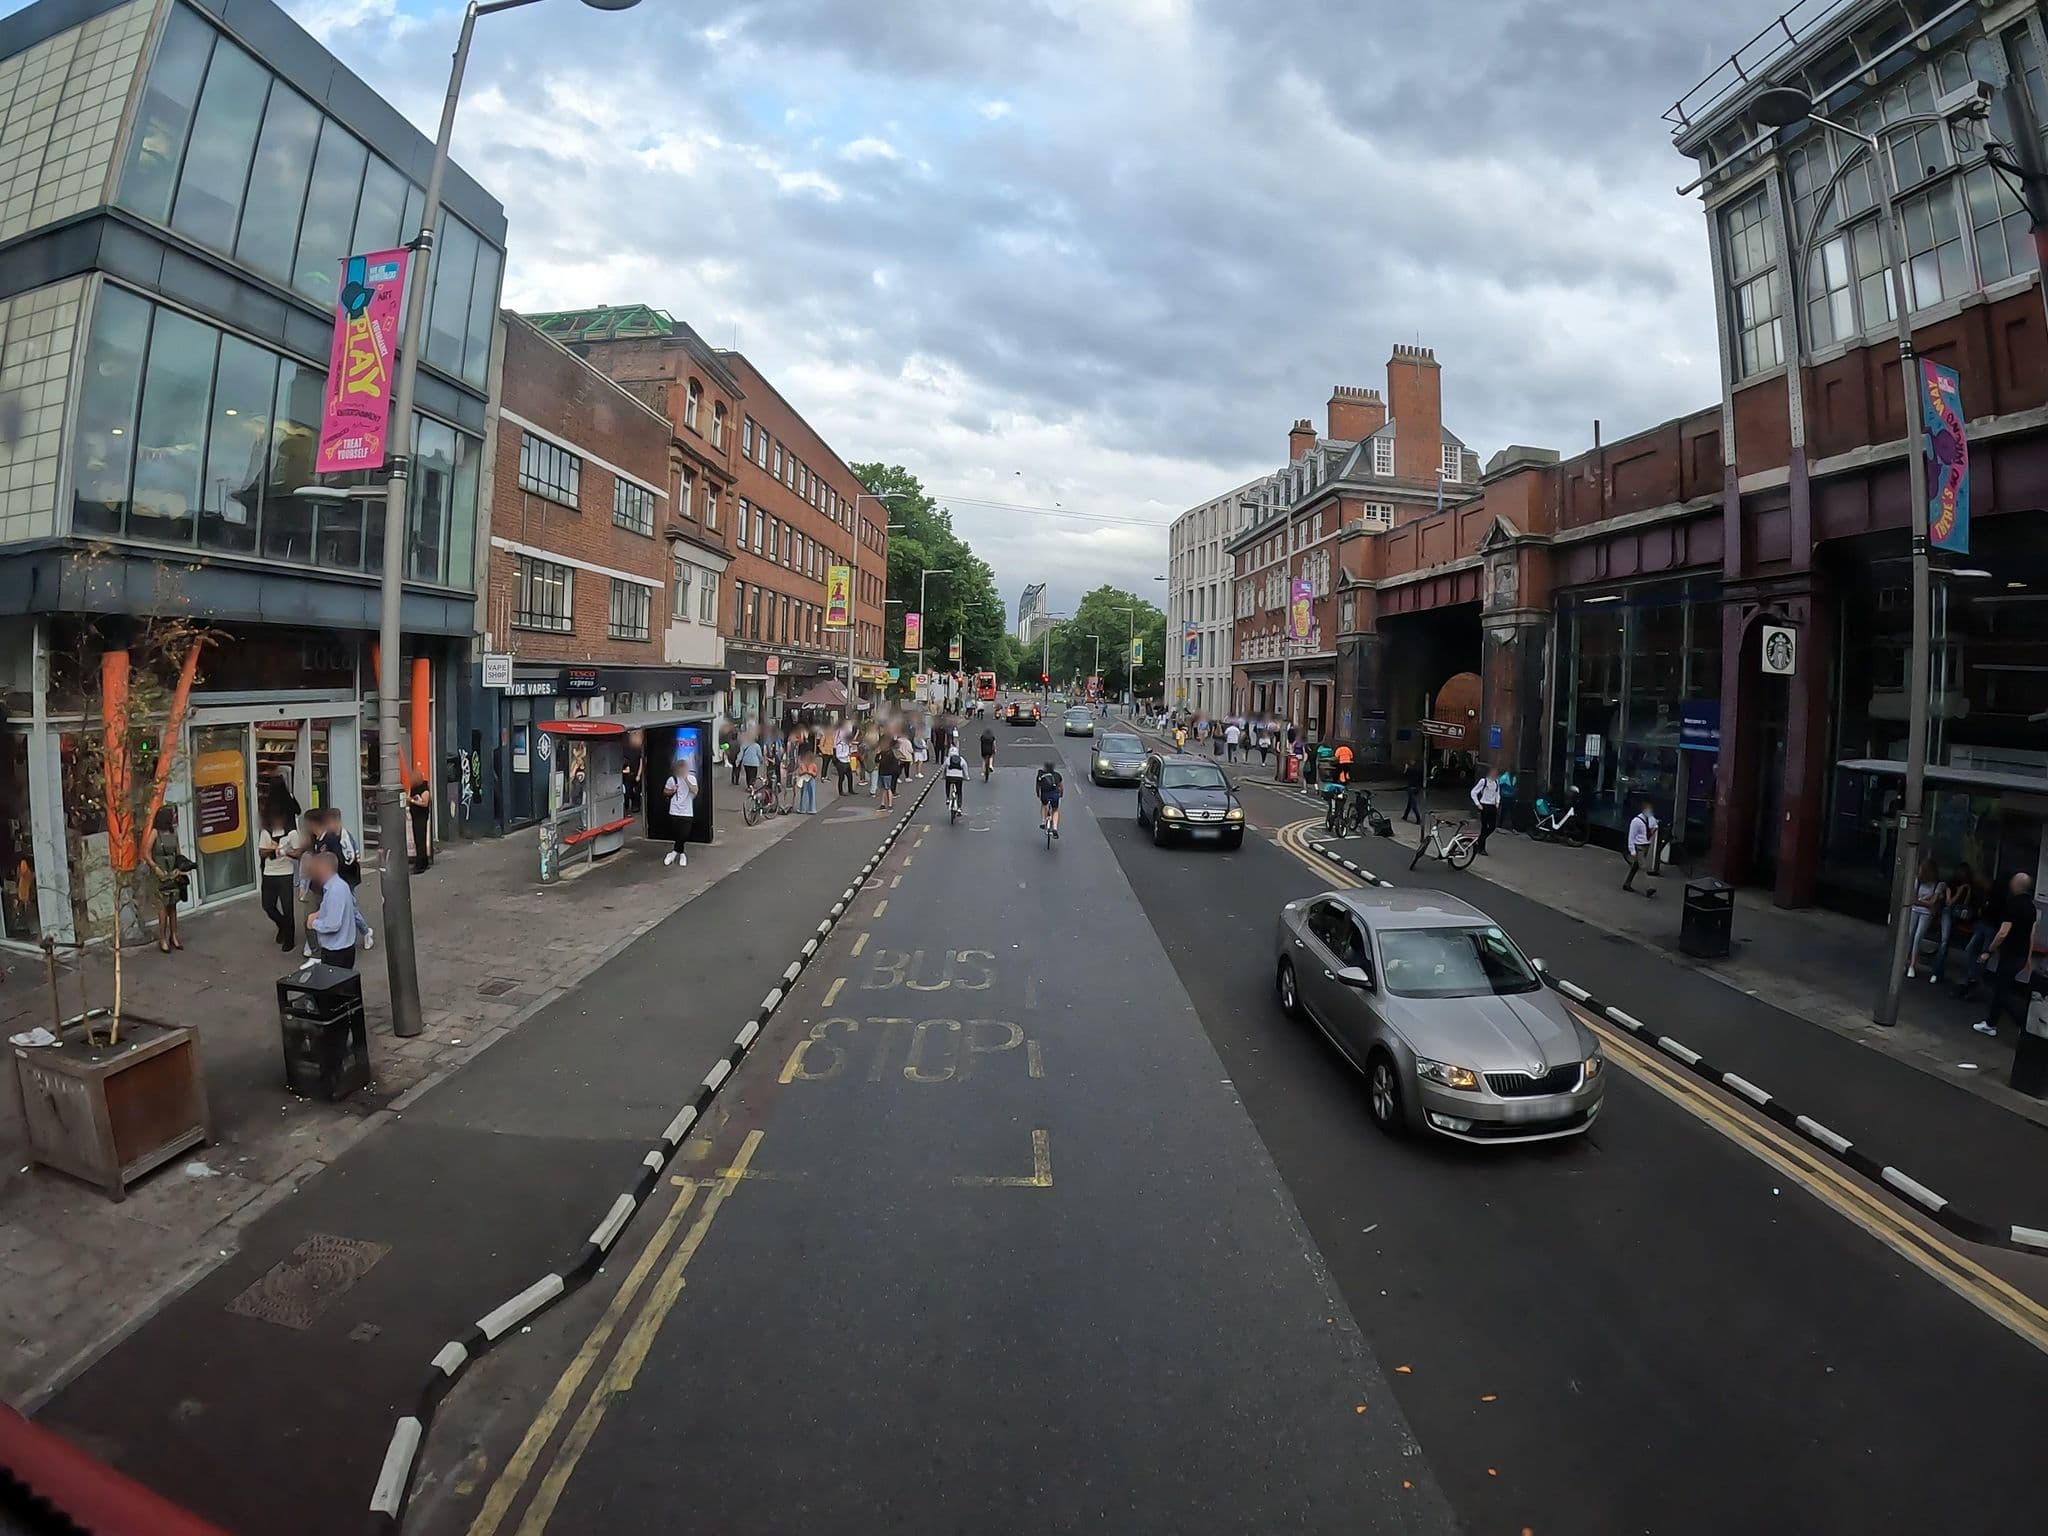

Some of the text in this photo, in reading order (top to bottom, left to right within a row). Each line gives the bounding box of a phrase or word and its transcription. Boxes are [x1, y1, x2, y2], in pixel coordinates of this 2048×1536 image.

[348, 315, 381, 398] PLAY
[1928, 380, 1946, 417] WAY
[337, 447, 368, 460] YOURSELF
[343, 437, 362, 449] TREAT
[1936, 487, 1954, 539] THERE'S
[487, 664, 507, 672] VAPE
[487, 671, 506, 679] SHOP
[527, 683, 551, 695] VAPES
[860, 949, 996, 991] BUS
[792, 1017, 1025, 1082] STOP
